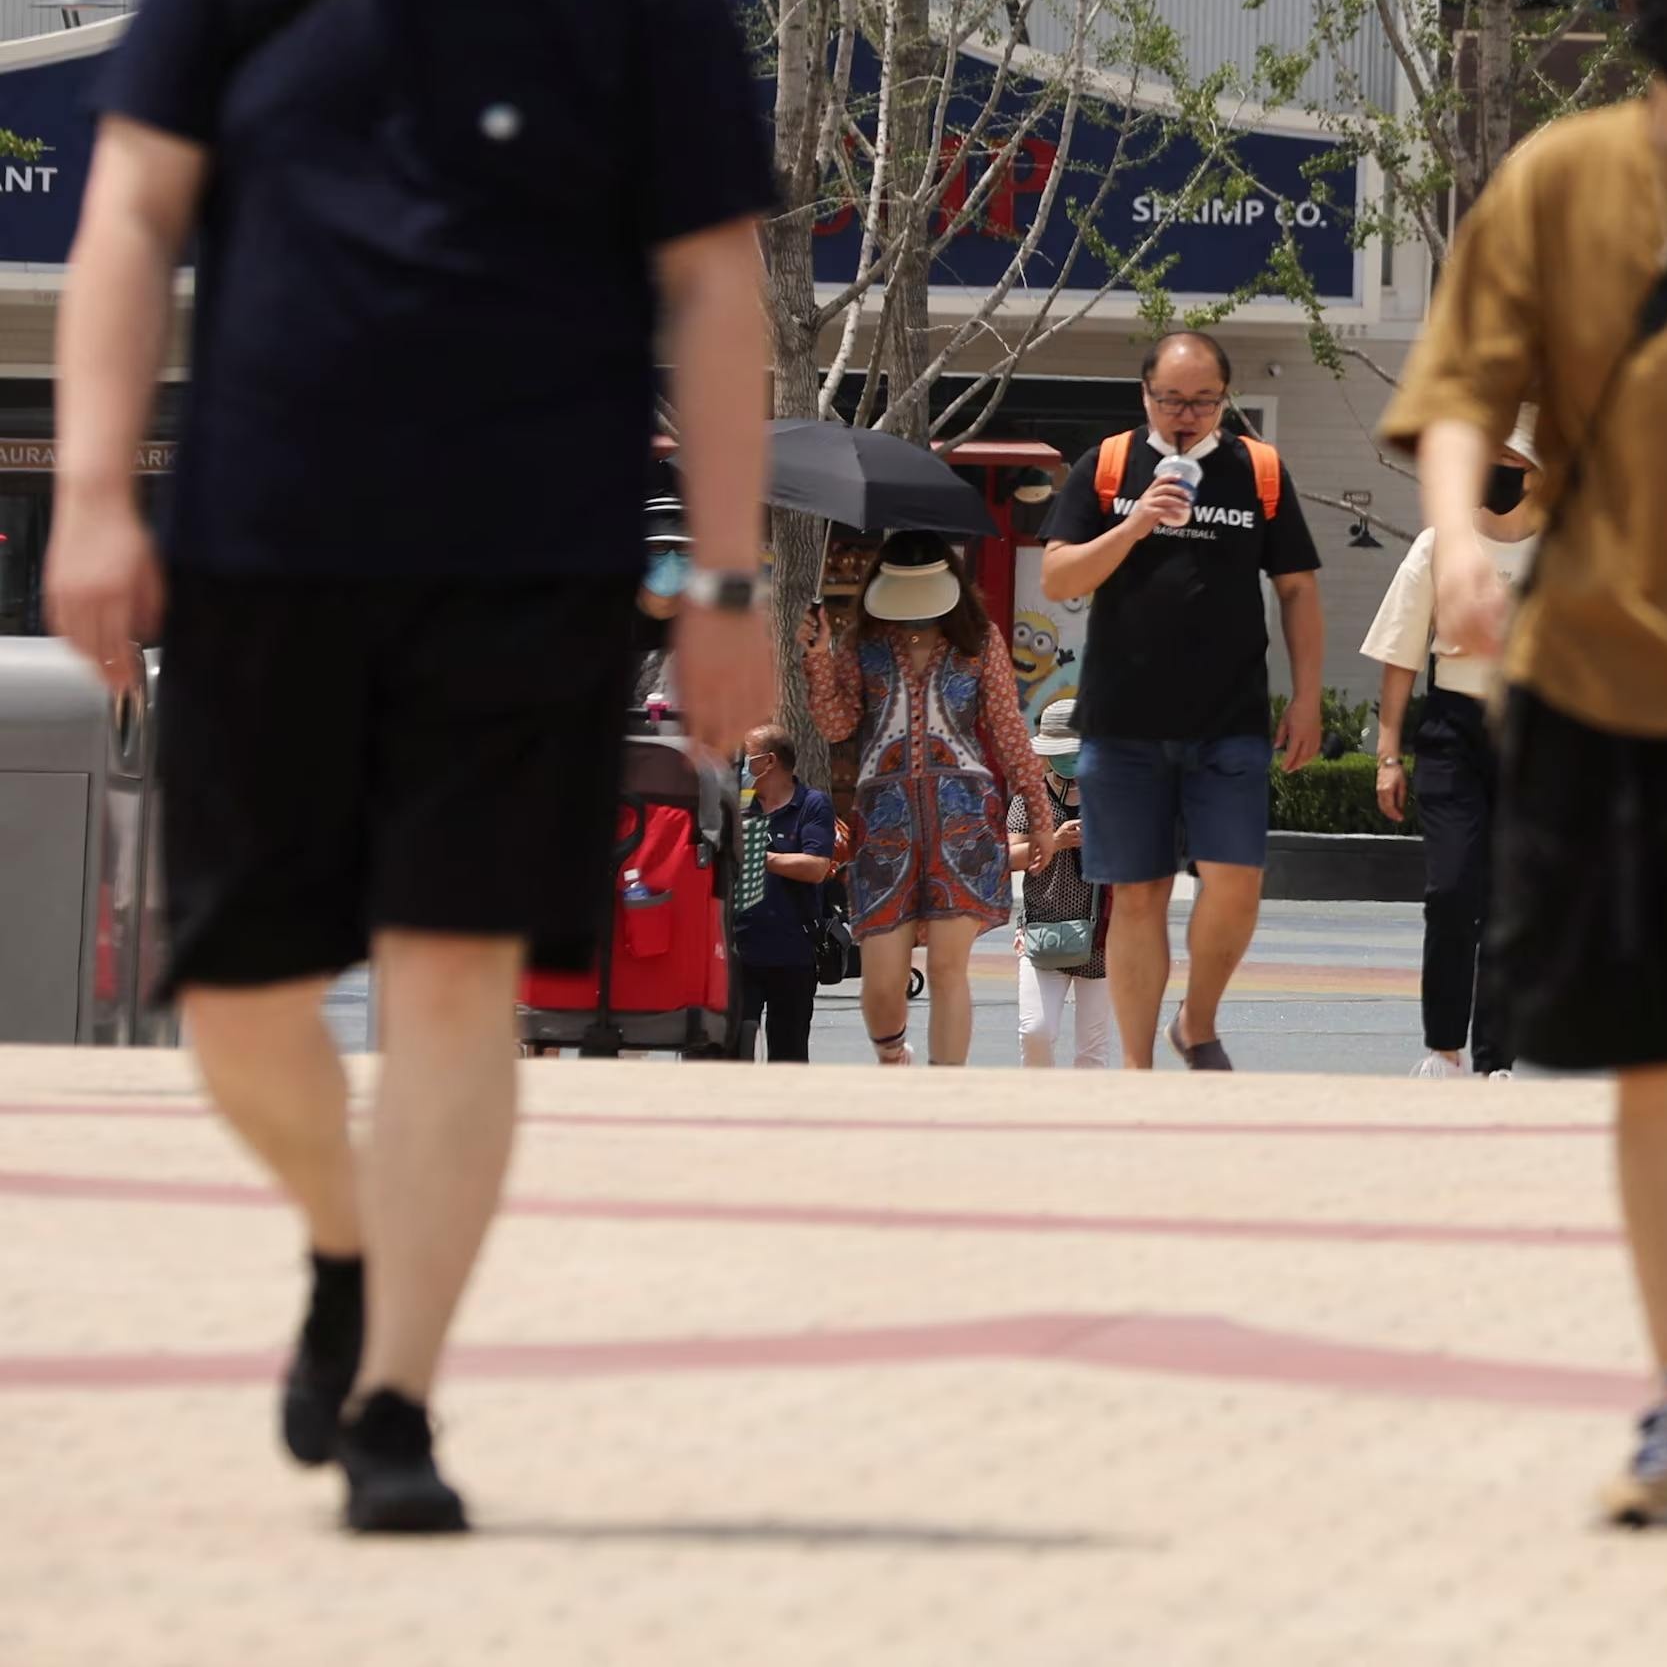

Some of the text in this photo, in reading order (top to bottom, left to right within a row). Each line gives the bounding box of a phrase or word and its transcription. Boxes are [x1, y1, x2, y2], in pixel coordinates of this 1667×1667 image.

[0, 165, 58, 193] NT
[1132, 195, 1328, 228] SHRIMP CO.
[1193, 505, 1255, 529] WADE
